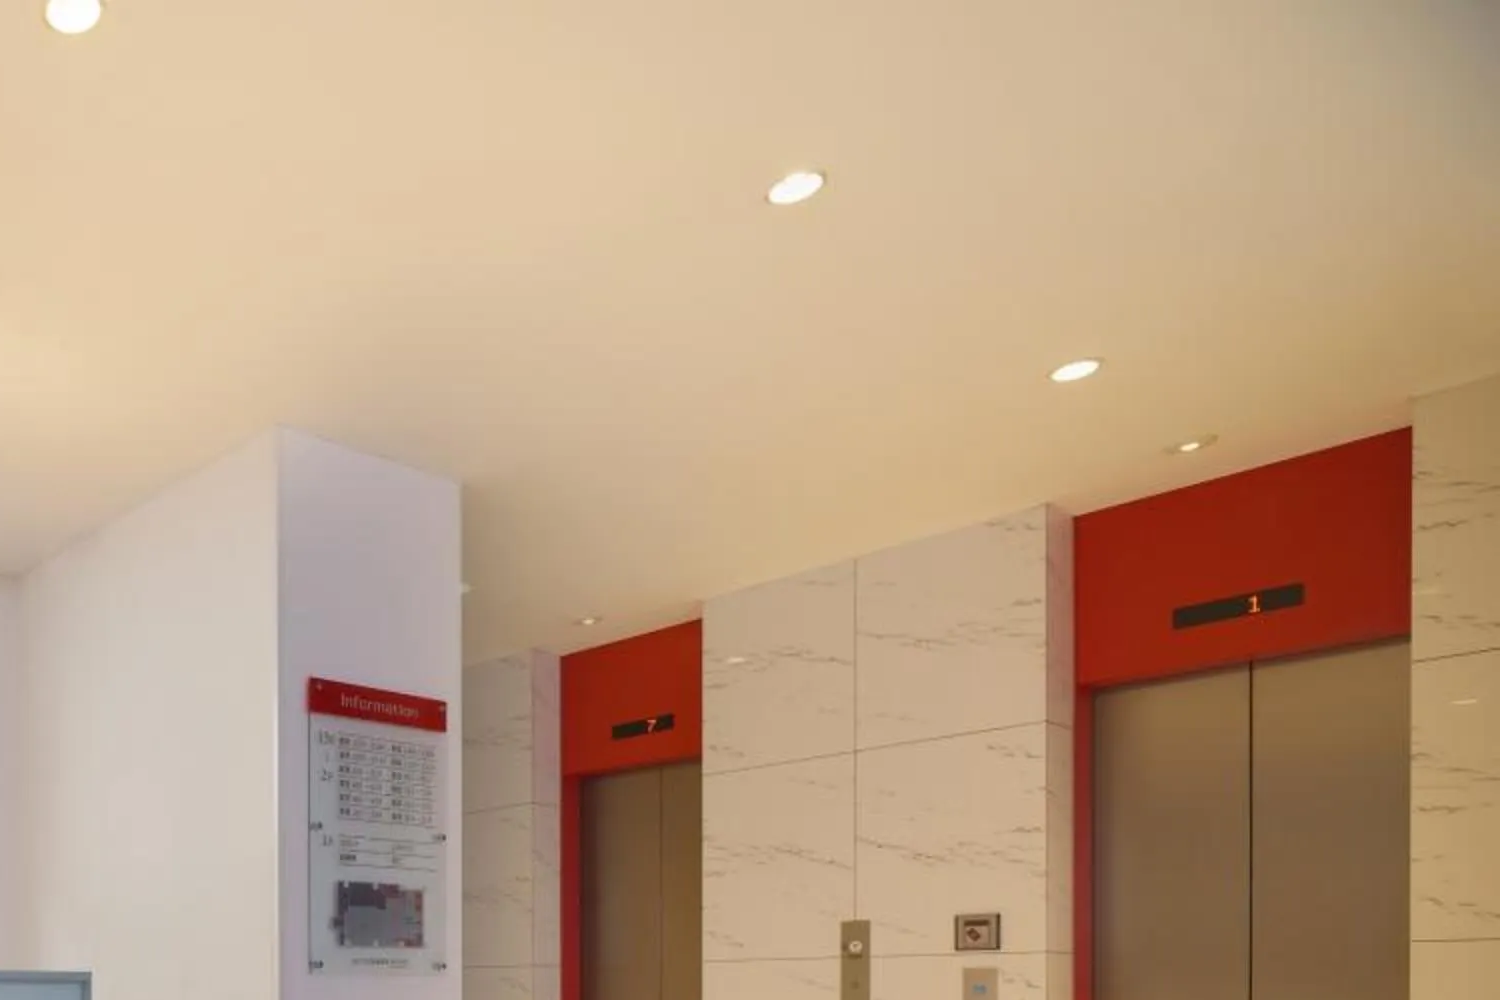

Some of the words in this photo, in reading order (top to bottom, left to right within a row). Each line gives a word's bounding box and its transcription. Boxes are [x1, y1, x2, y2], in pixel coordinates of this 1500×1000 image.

[1248, 595, 1261, 613] 1
[341, 692, 418, 717] Information
[647, 719, 657, 733] 7
